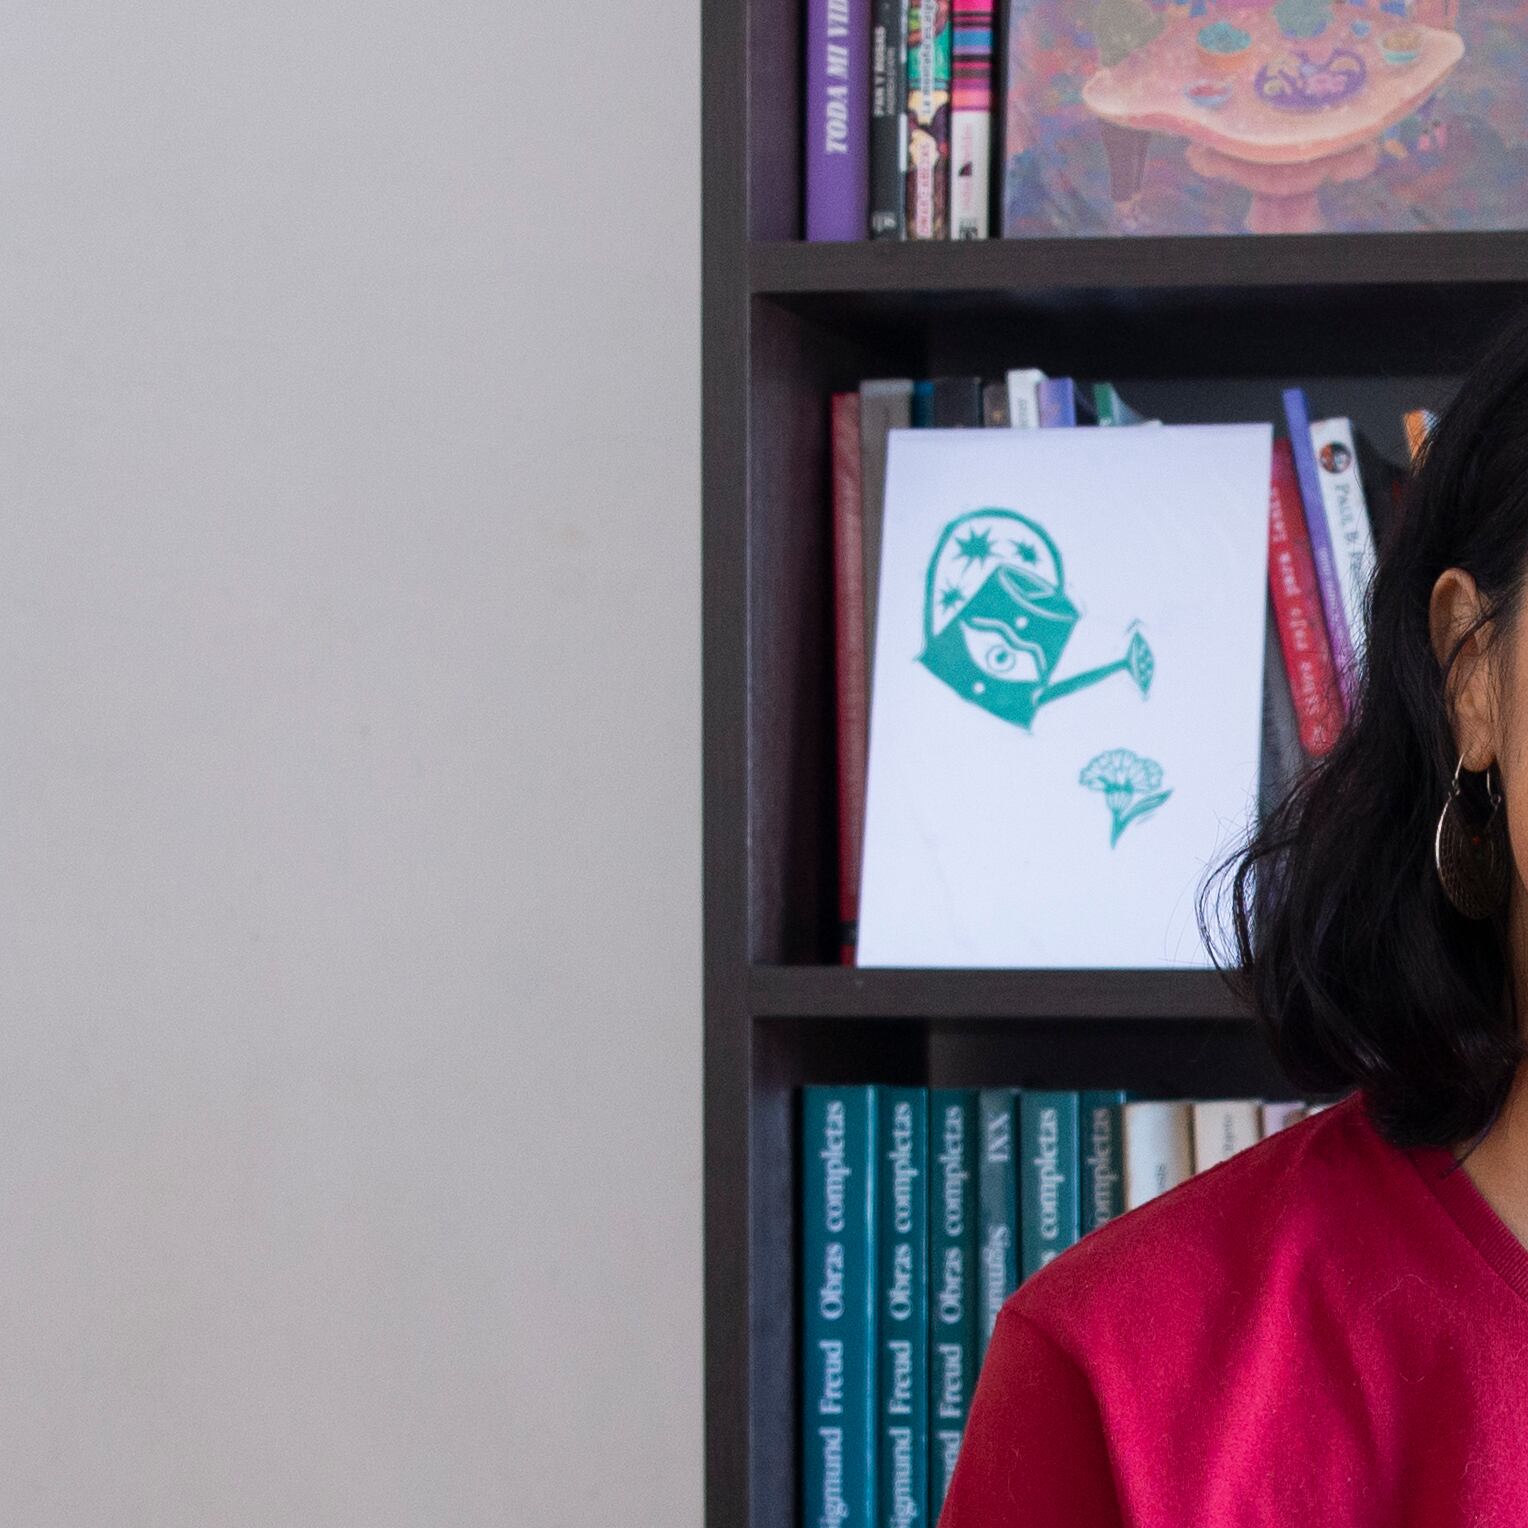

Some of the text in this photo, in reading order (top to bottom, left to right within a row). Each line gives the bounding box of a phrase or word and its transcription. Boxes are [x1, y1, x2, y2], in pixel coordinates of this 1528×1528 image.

[825, 43, 850, 79] MI
[825, 86, 850, 154] TODA
[819, 1102, 846, 1233] completas
[889, 1102, 918, 1233] completas
[939, 1105, 968, 1236] completas
[1034, 1107, 1066, 1240] completas
[1086, 1108, 1119, 1224] ompletas
[819, 1242, 846, 1320] Obras
[889, 1242, 913, 1320] Obras
[939, 1246, 966, 1324] Obras
[819, 1340, 844, 1415] Freud
[889, 1340, 913, 1415] Freud
[939, 1342, 962, 1419] Freud
